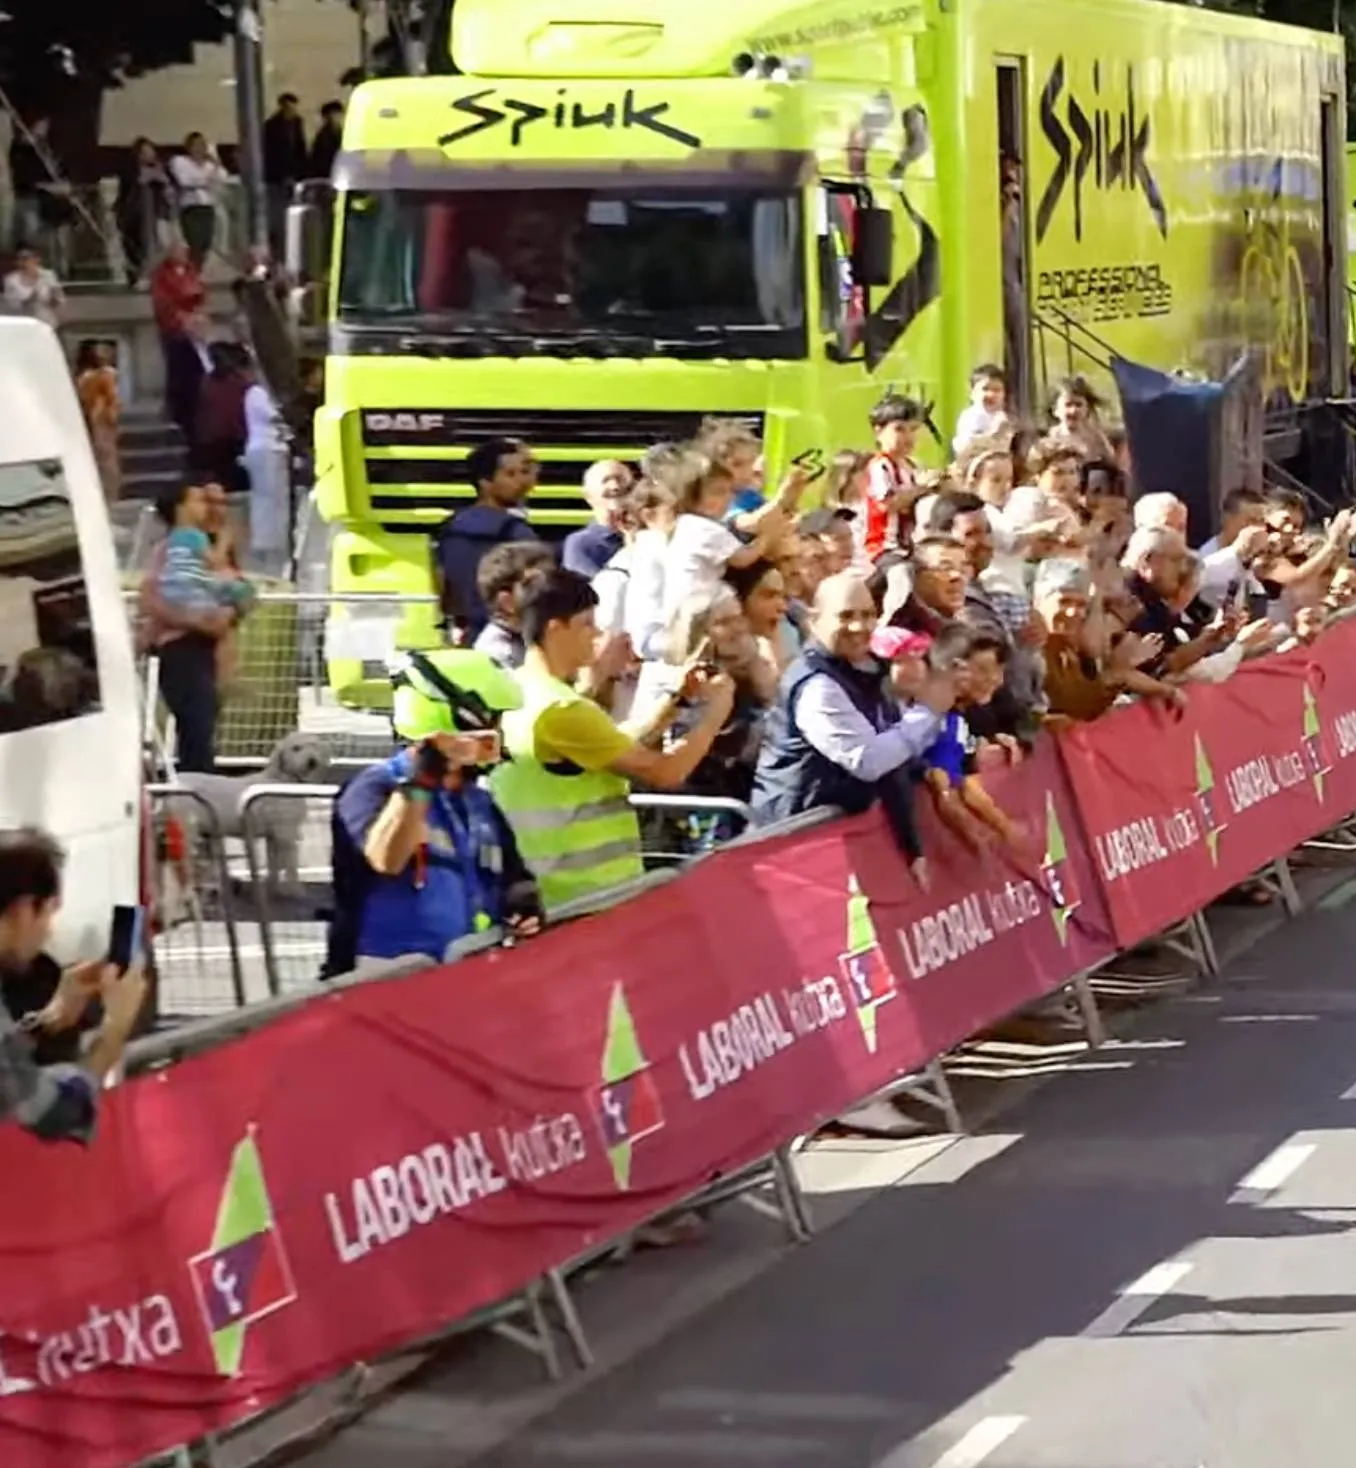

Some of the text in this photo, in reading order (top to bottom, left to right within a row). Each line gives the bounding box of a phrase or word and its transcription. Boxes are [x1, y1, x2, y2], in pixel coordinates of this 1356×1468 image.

[365, 413, 444, 431] DAF
[1224, 755, 1280, 813] LABORAL
[1095, 816, 1168, 881] LABORAL
[896, 892, 995, 980] LABORAL
[678, 990, 795, 1101] LABORAL
[324, 1112, 586, 1263] LABORAL kutxa
